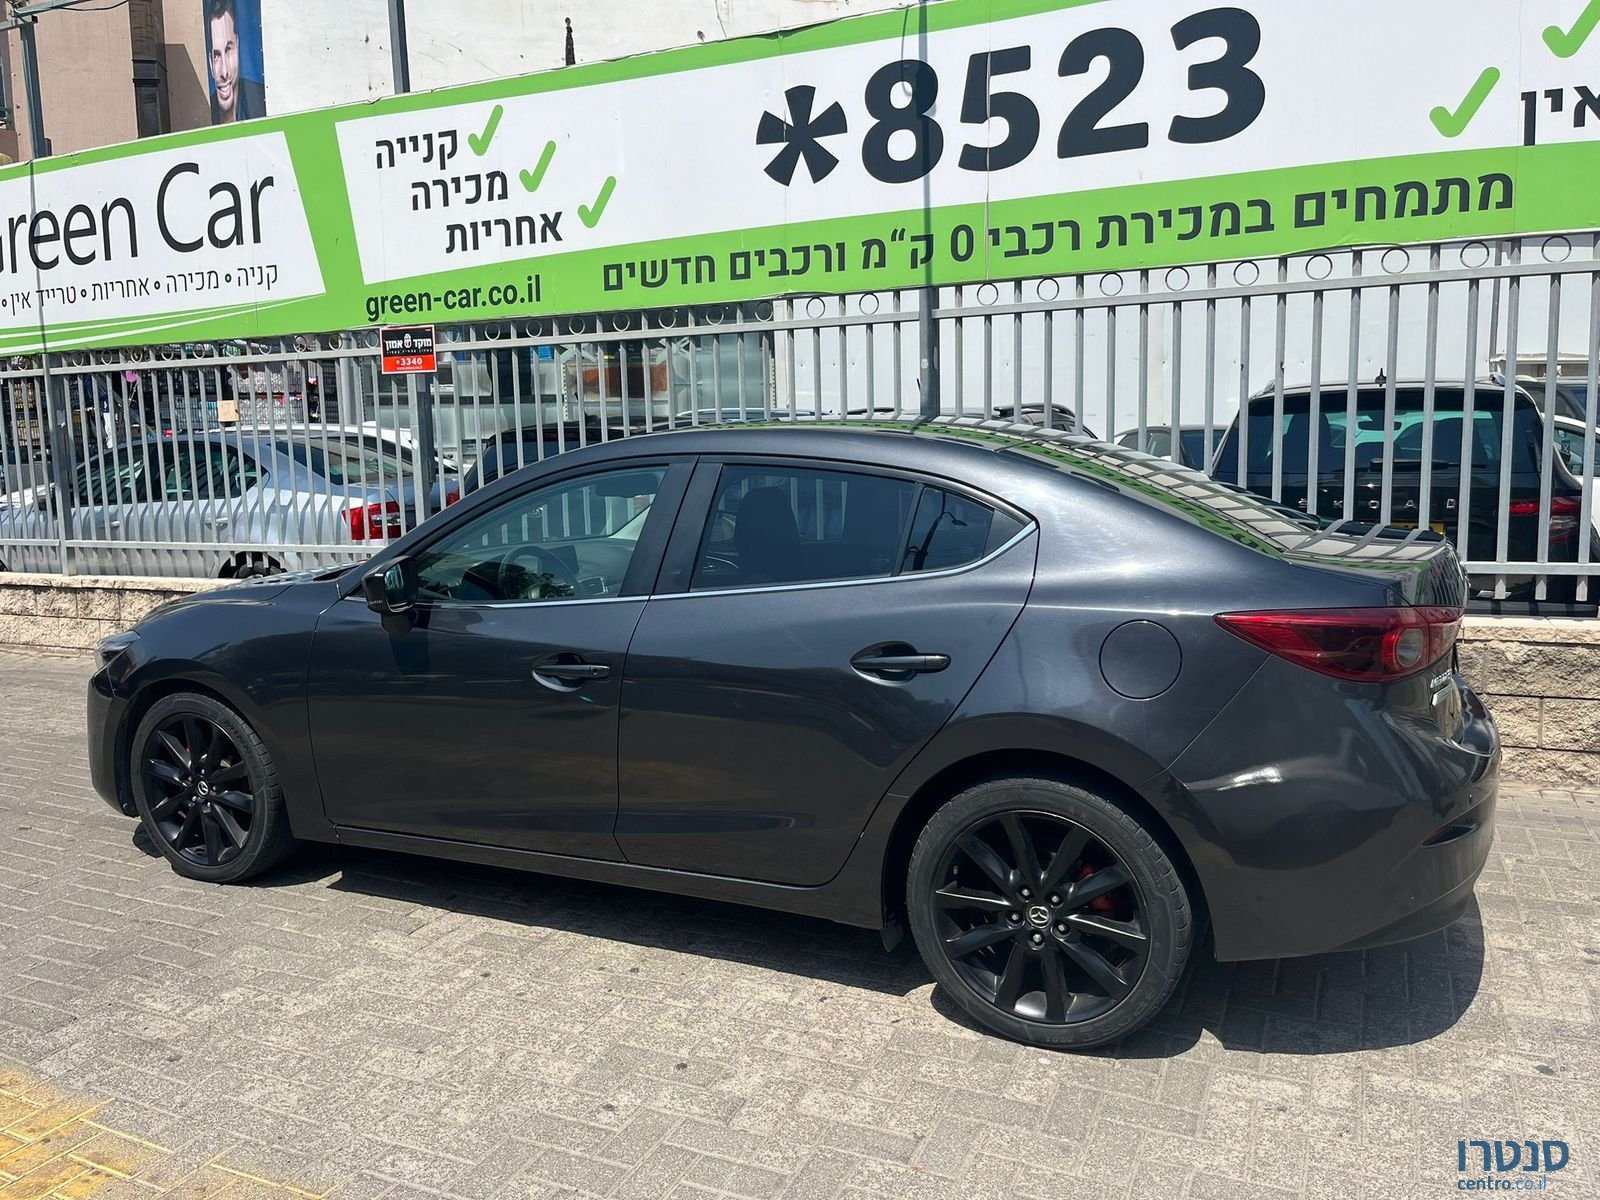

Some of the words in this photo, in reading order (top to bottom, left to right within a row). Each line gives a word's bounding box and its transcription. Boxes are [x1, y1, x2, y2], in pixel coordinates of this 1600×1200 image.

[376, 130, 457, 170] קנייה
[412, 171, 507, 210] מכירה
[1295, 173, 1512, 228] מתמחים
[0, 205, 137, 273] reen
[157, 163, 273, 252] Car
[446, 212, 562, 253] אחריות
[1097, 192, 1274, 248] במכירת
[951, 225, 973, 261] 0
[988, 220, 1080, 257] רכבי
[238, 265, 277, 290] קניה
[604, 256, 715, 291] חדשים
[730, 243, 845, 280] ורכבים
[36, 286, 76, 307] טרייד
[92, 278, 149, 301] אחריות
[167, 271, 218, 292] מכירה
[367, 274, 540, 322] green-car.co.il
[11, 292, 31, 315] אין
[385, 339, 403, 351] אמון
[412, 338, 432, 349] מוקד
